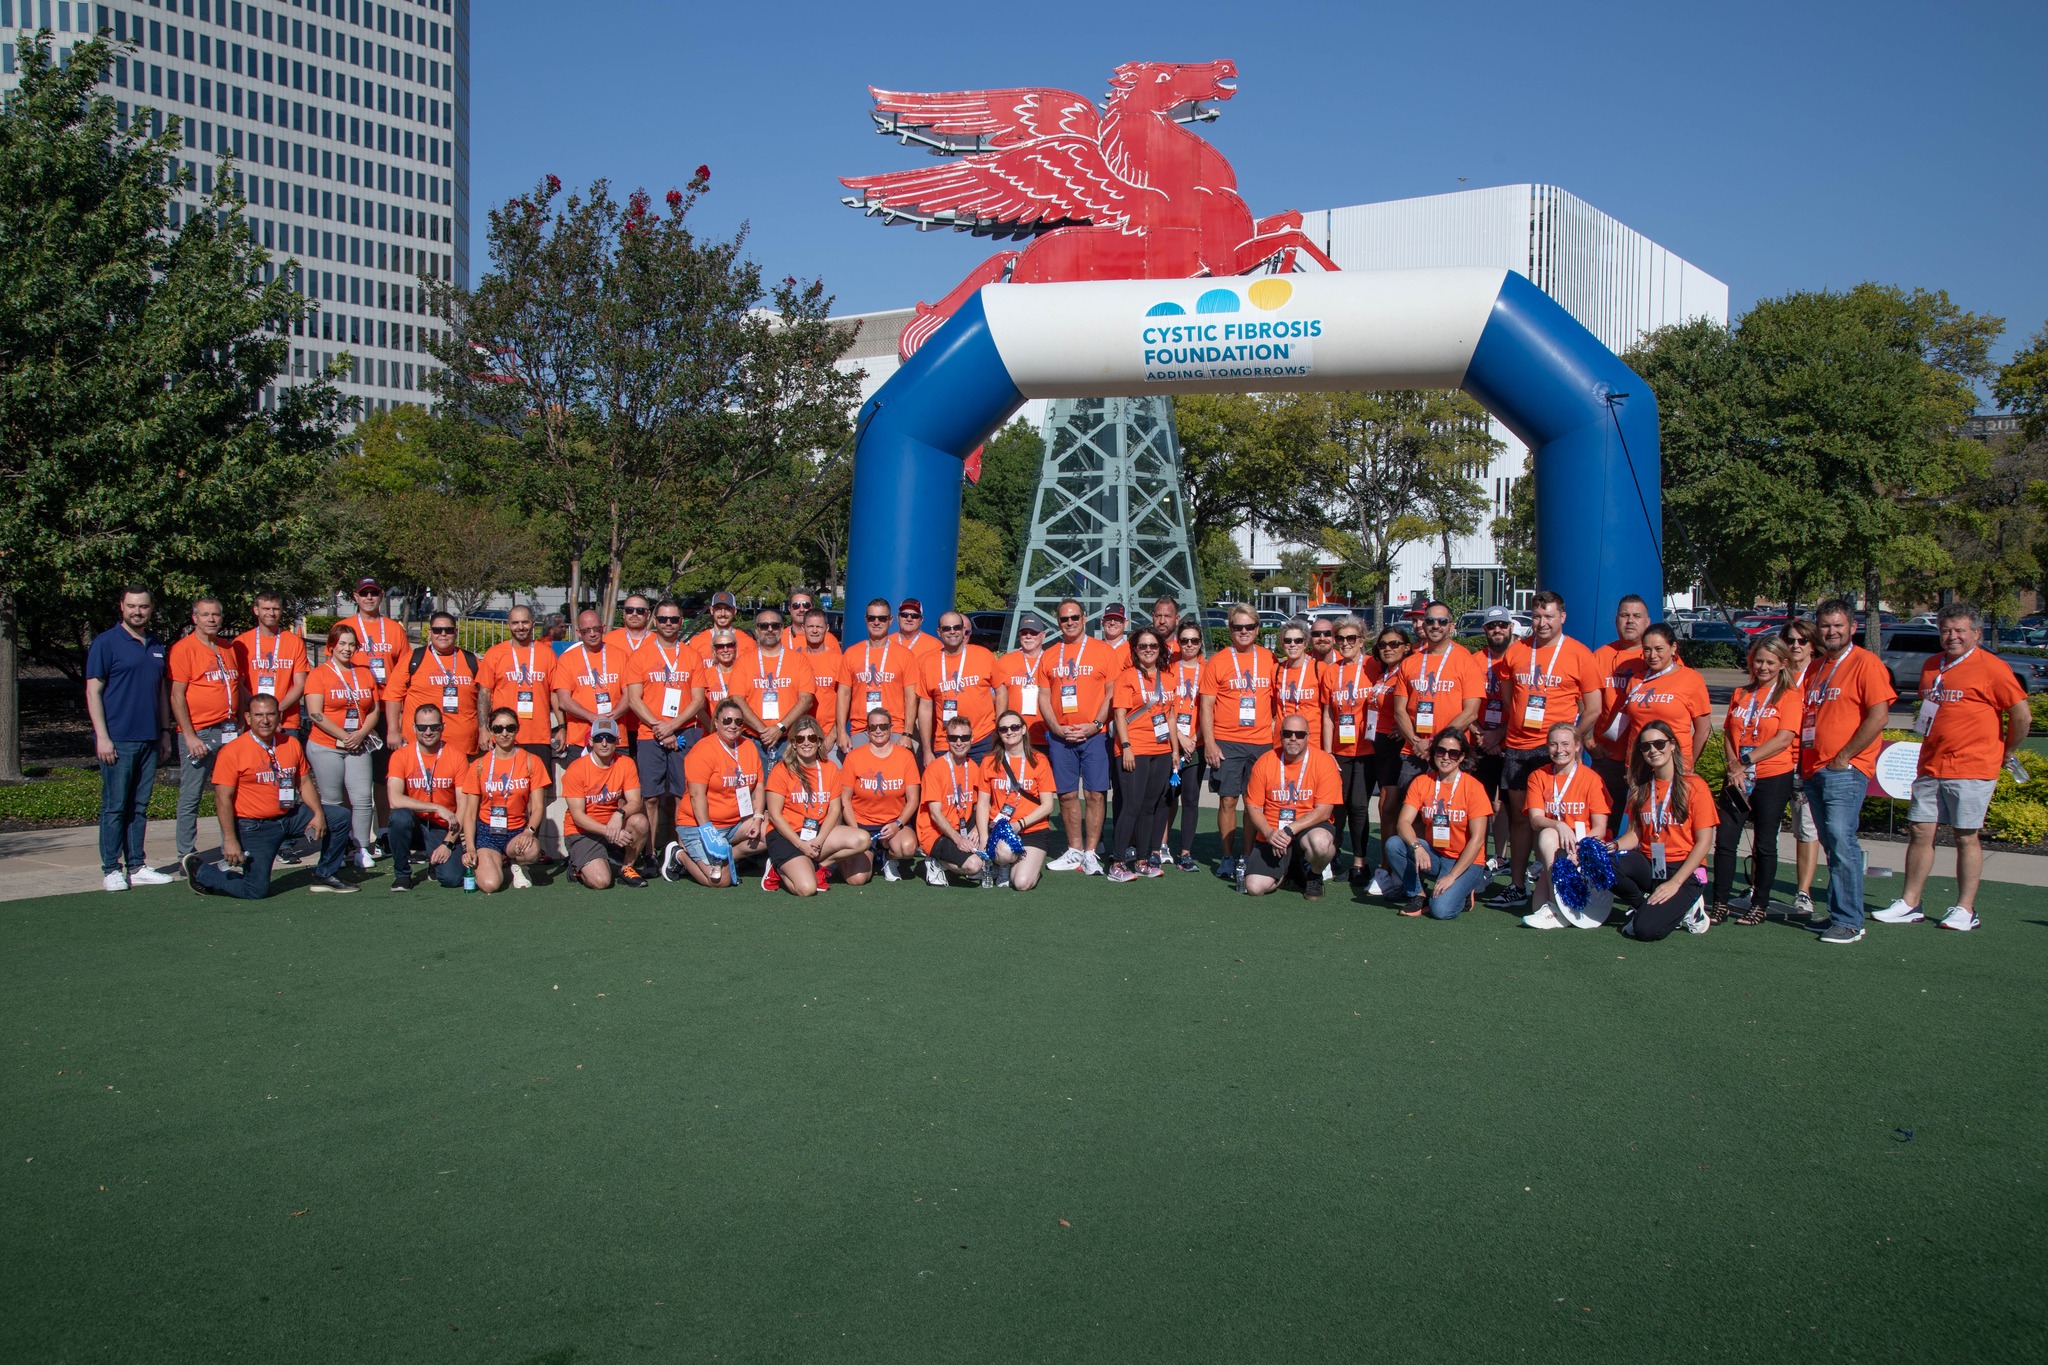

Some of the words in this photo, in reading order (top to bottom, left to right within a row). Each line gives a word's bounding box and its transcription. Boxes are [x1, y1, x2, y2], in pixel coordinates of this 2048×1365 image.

[1143, 325, 1217, 344] CYSTIC
[1225, 320, 1321, 340] FIBROSIS
[1147, 370, 1203, 379] ADDING
[373, 643, 392, 652] STEP
[252, 659, 269, 670] TWO
[274, 659, 293, 670] STEP
[702, 659, 714, 668] TW
[506, 671, 523, 681] TWO
[526, 671, 545, 681] STEP
[649, 672, 665, 682] TWO
[669, 671, 689, 682] STEP
[1053, 667, 1069, 677] TWO
[1074, 666, 1093, 676] STEP
[429, 676, 448, 685] TWO
[454, 676, 472, 685] STEP
[600, 673, 618, 684] STEP
[753, 678, 769, 688] TWO
[772, 678, 791, 688] STEP
[856, 673, 871, 683] TWO
[876, 672, 894, 683] STEP
[1011, 677, 1026, 686] TWO
[1539, 675, 1562, 687] STEP
[1606, 678, 1626, 688] TWO
[939, 682, 956, 693] TWO
[959, 676, 979, 688] STEP
[1229, 679, 1247, 689] TWO
[1251, 678, 1269, 688] STEP
[1433, 681, 1454, 692] STEP
[1648, 694, 1674, 703] STEP
[1939, 690, 1964, 701] STEP
[256, 772, 274, 783] TWO
[408, 778, 427, 789] TWO
[432, 778, 453, 789] STEP
[485, 781, 503, 792] TWO
[508, 779, 529, 790] STEP
[860, 779, 877, 790] TWO
[882, 779, 903, 790] STEP
[1272, 790, 1290, 801] TWO
[1294, 790, 1312, 800] STEP
[1561, 802, 1585, 814] STEP
